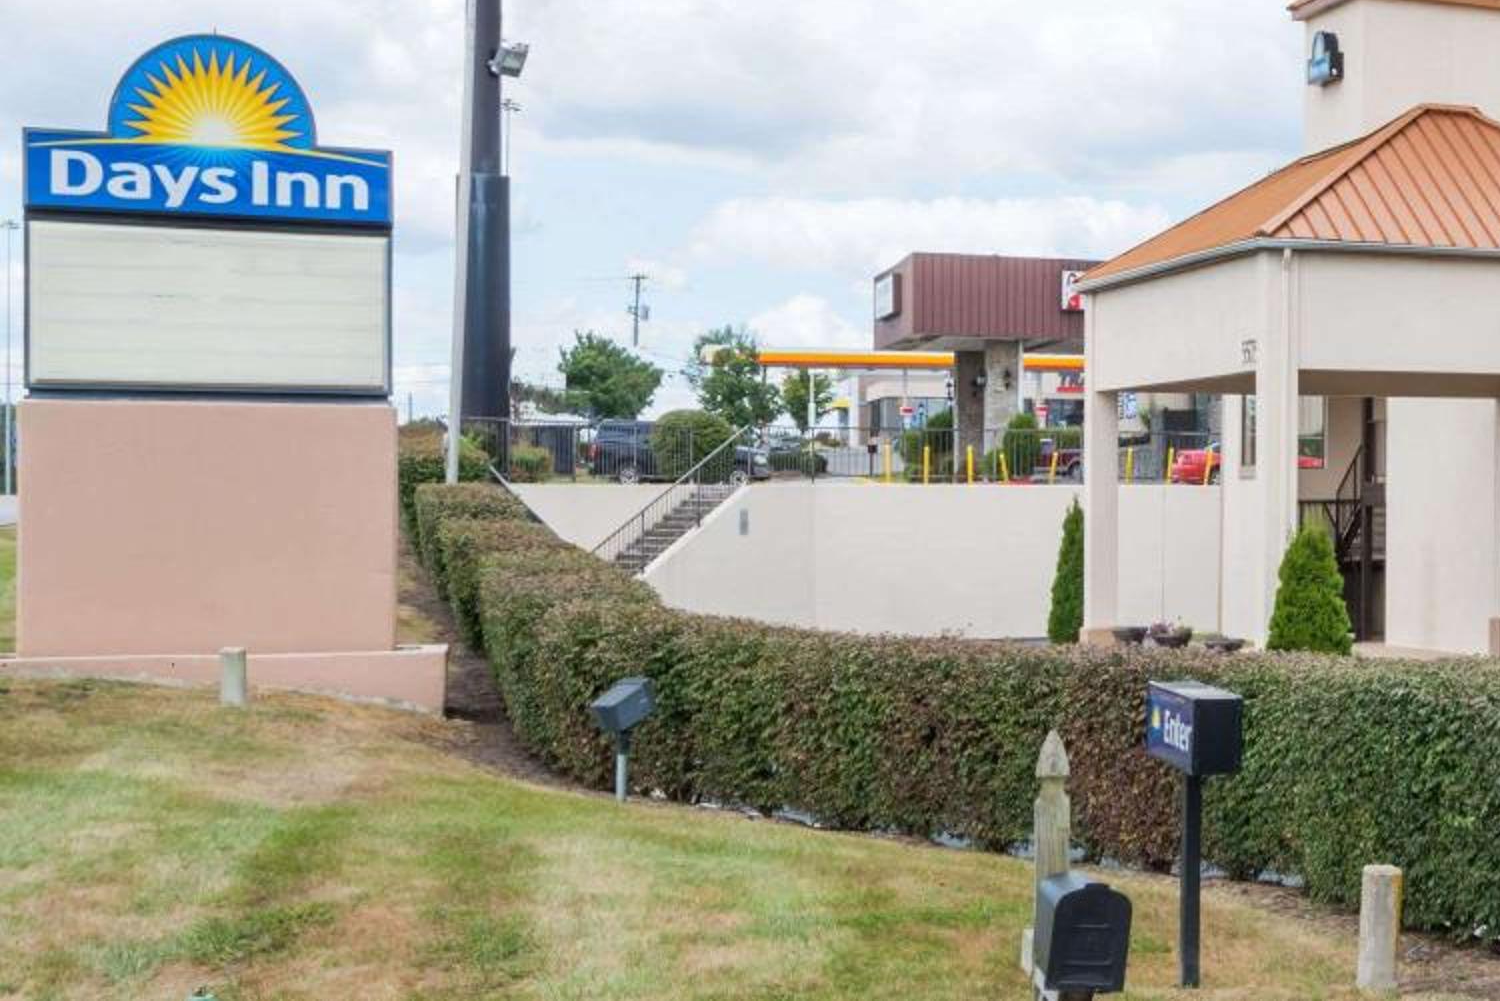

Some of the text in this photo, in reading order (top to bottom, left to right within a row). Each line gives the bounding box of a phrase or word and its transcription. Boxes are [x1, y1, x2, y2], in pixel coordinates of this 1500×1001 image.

[50, 149, 369, 210] Days Inn
[1163, 709, 1192, 752] Enter
